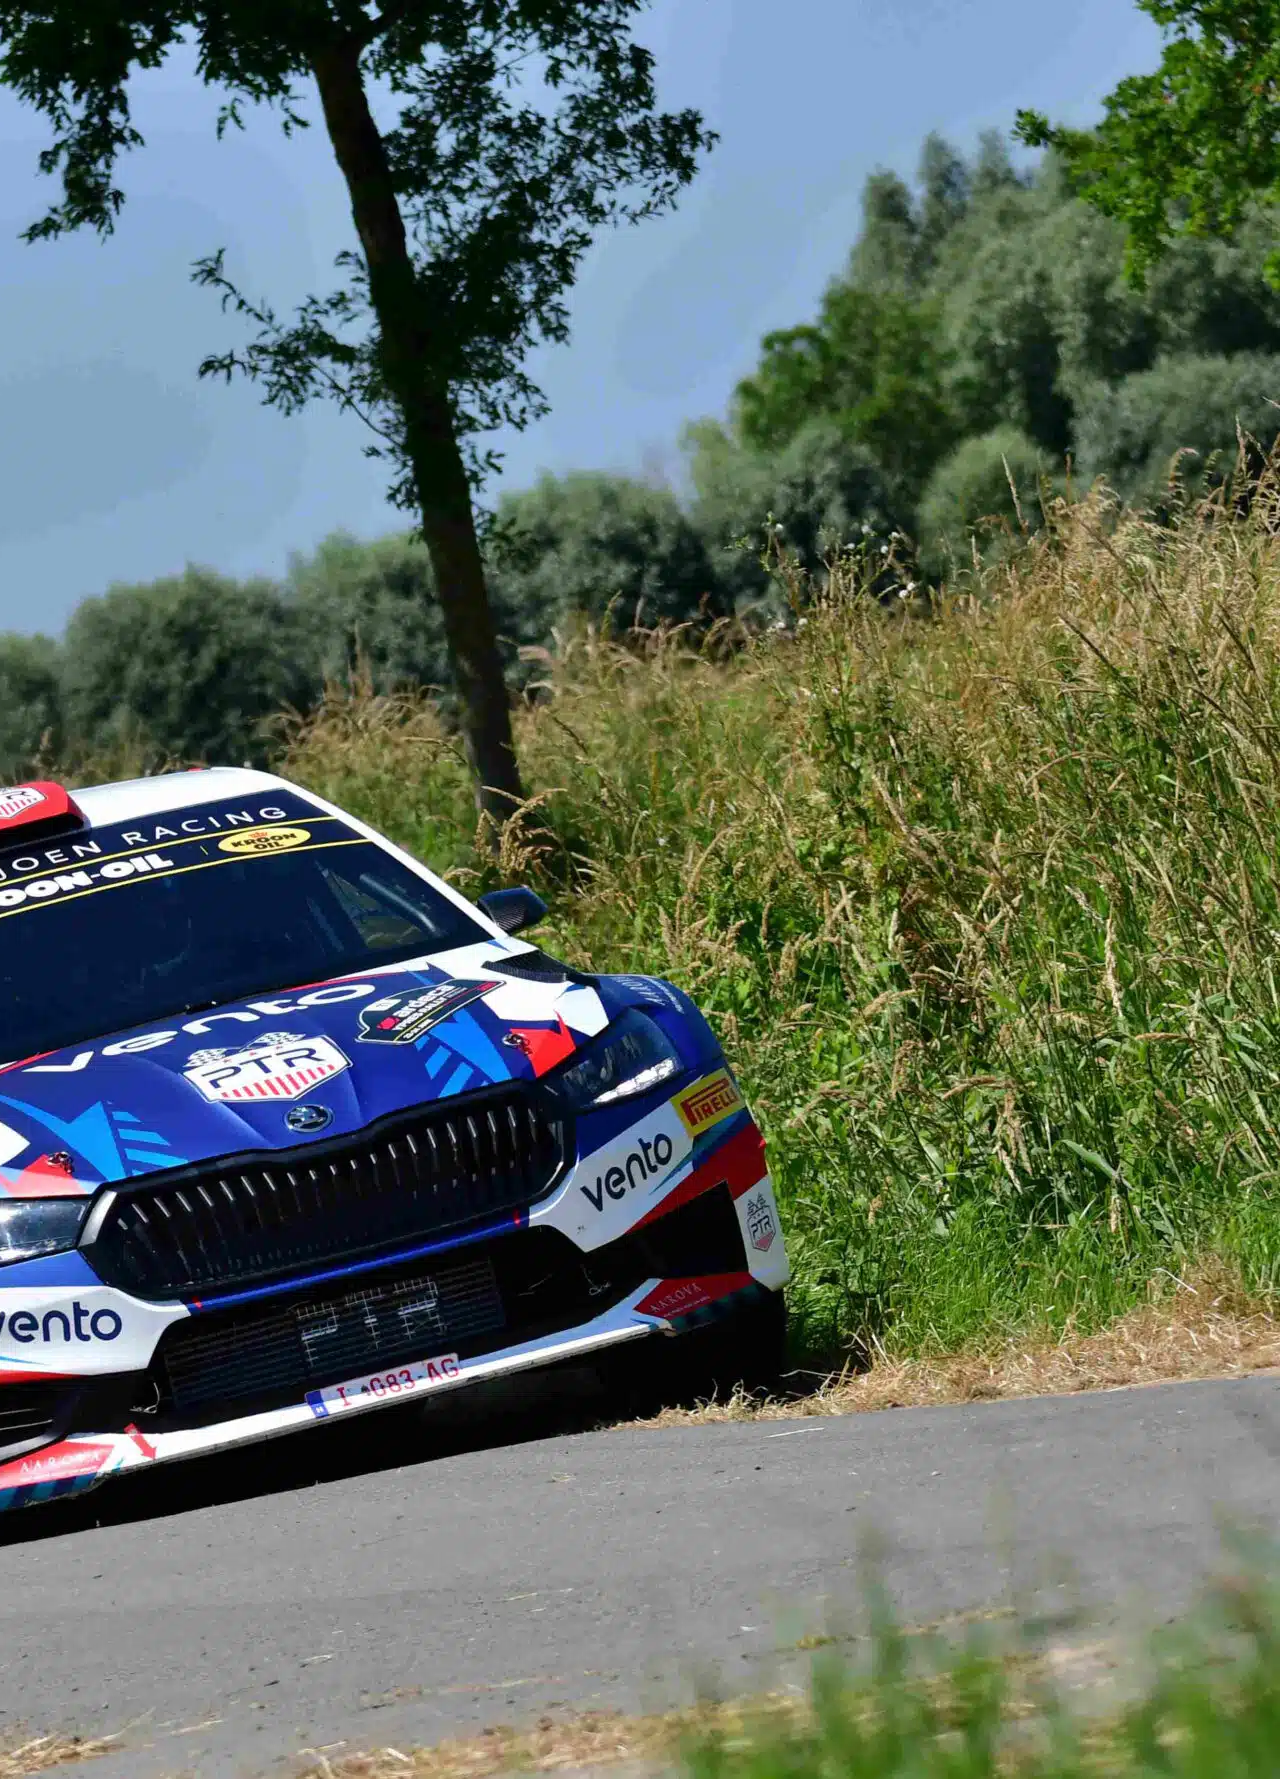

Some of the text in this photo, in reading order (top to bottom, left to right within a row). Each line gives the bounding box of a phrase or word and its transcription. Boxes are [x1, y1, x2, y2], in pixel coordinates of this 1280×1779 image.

[123, 805, 288, 846] RACING
[230, 832, 298, 849] KROON
[254, 841, 285, 851] OIL
[22, 984, 376, 1074] vento
[200, 1046, 330, 1090] PTR
[679, 1076, 741, 1127] PIRELLI
[580, 1132, 673, 1213] vento
[750, 1214, 772, 1238] PTR
